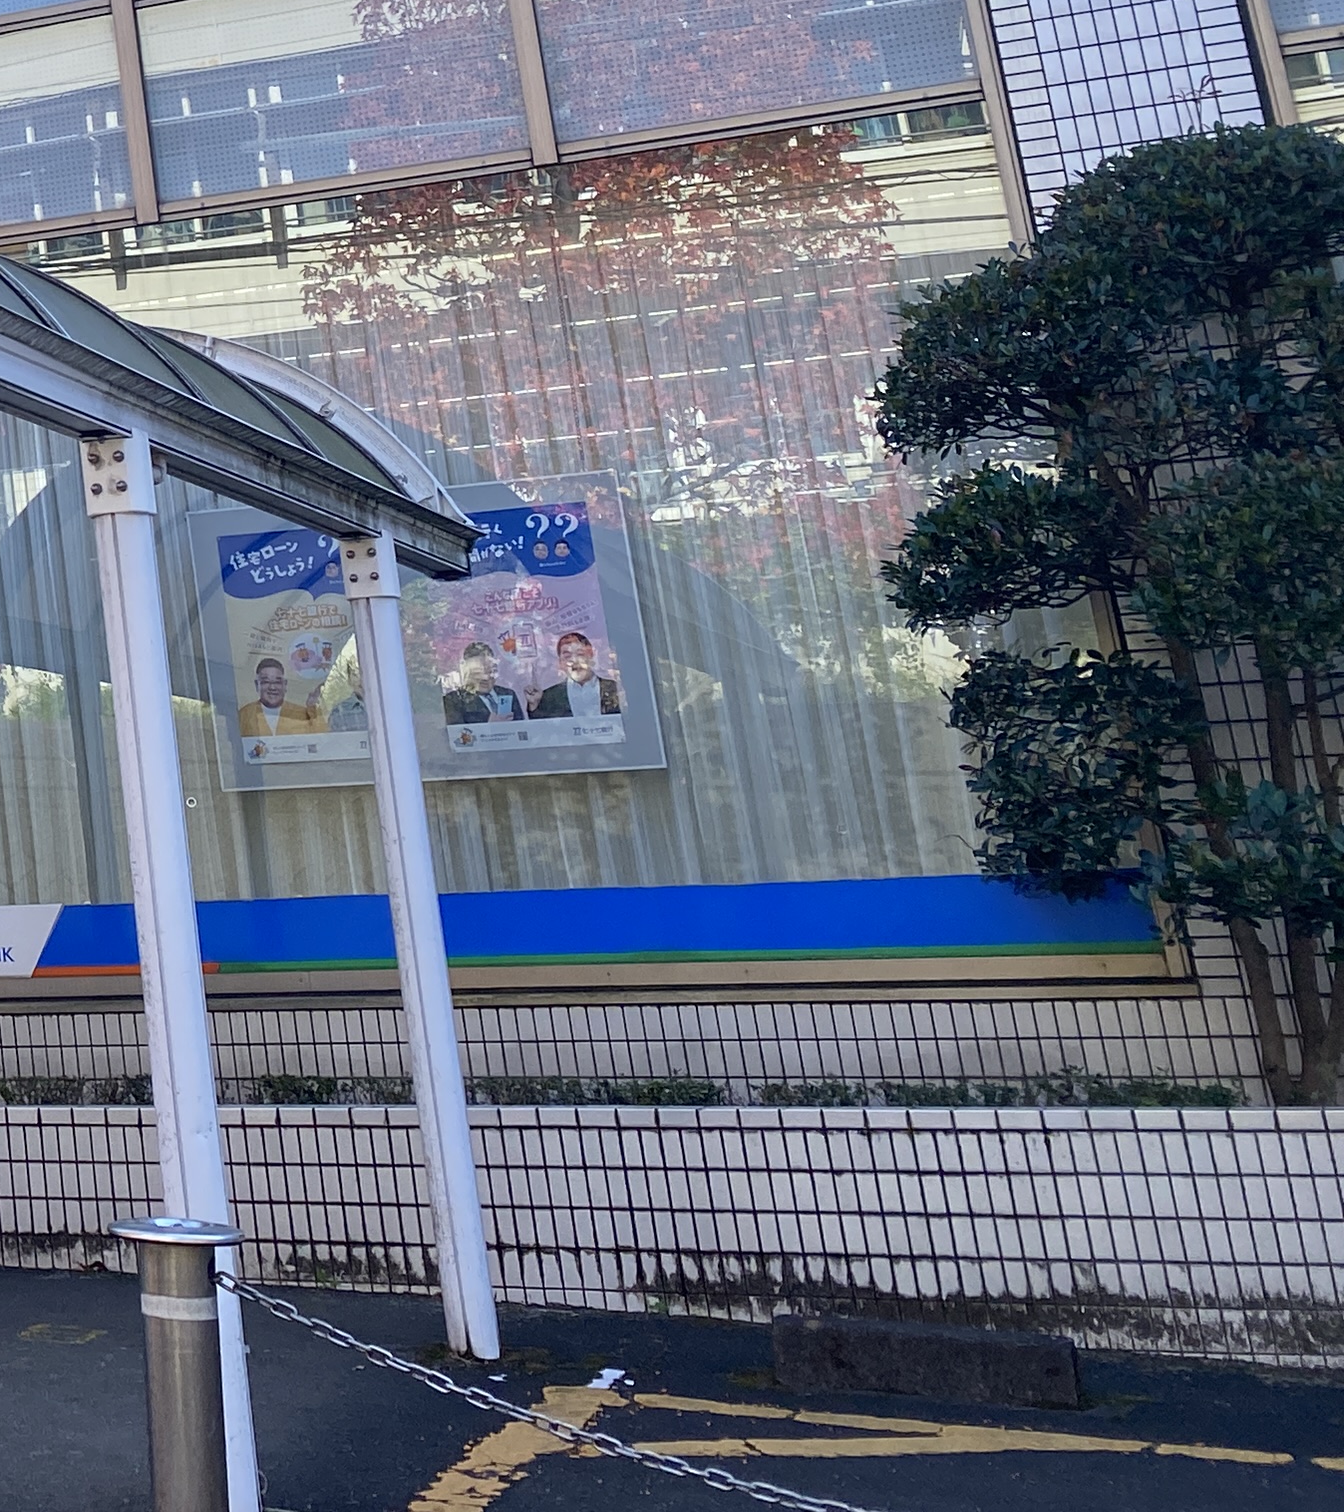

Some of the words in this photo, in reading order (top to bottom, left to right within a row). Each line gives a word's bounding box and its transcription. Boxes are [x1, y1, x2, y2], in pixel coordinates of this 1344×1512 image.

[229, 541, 298, 571] 住宅ローン
[249, 556, 314, 584] どうしよう!
